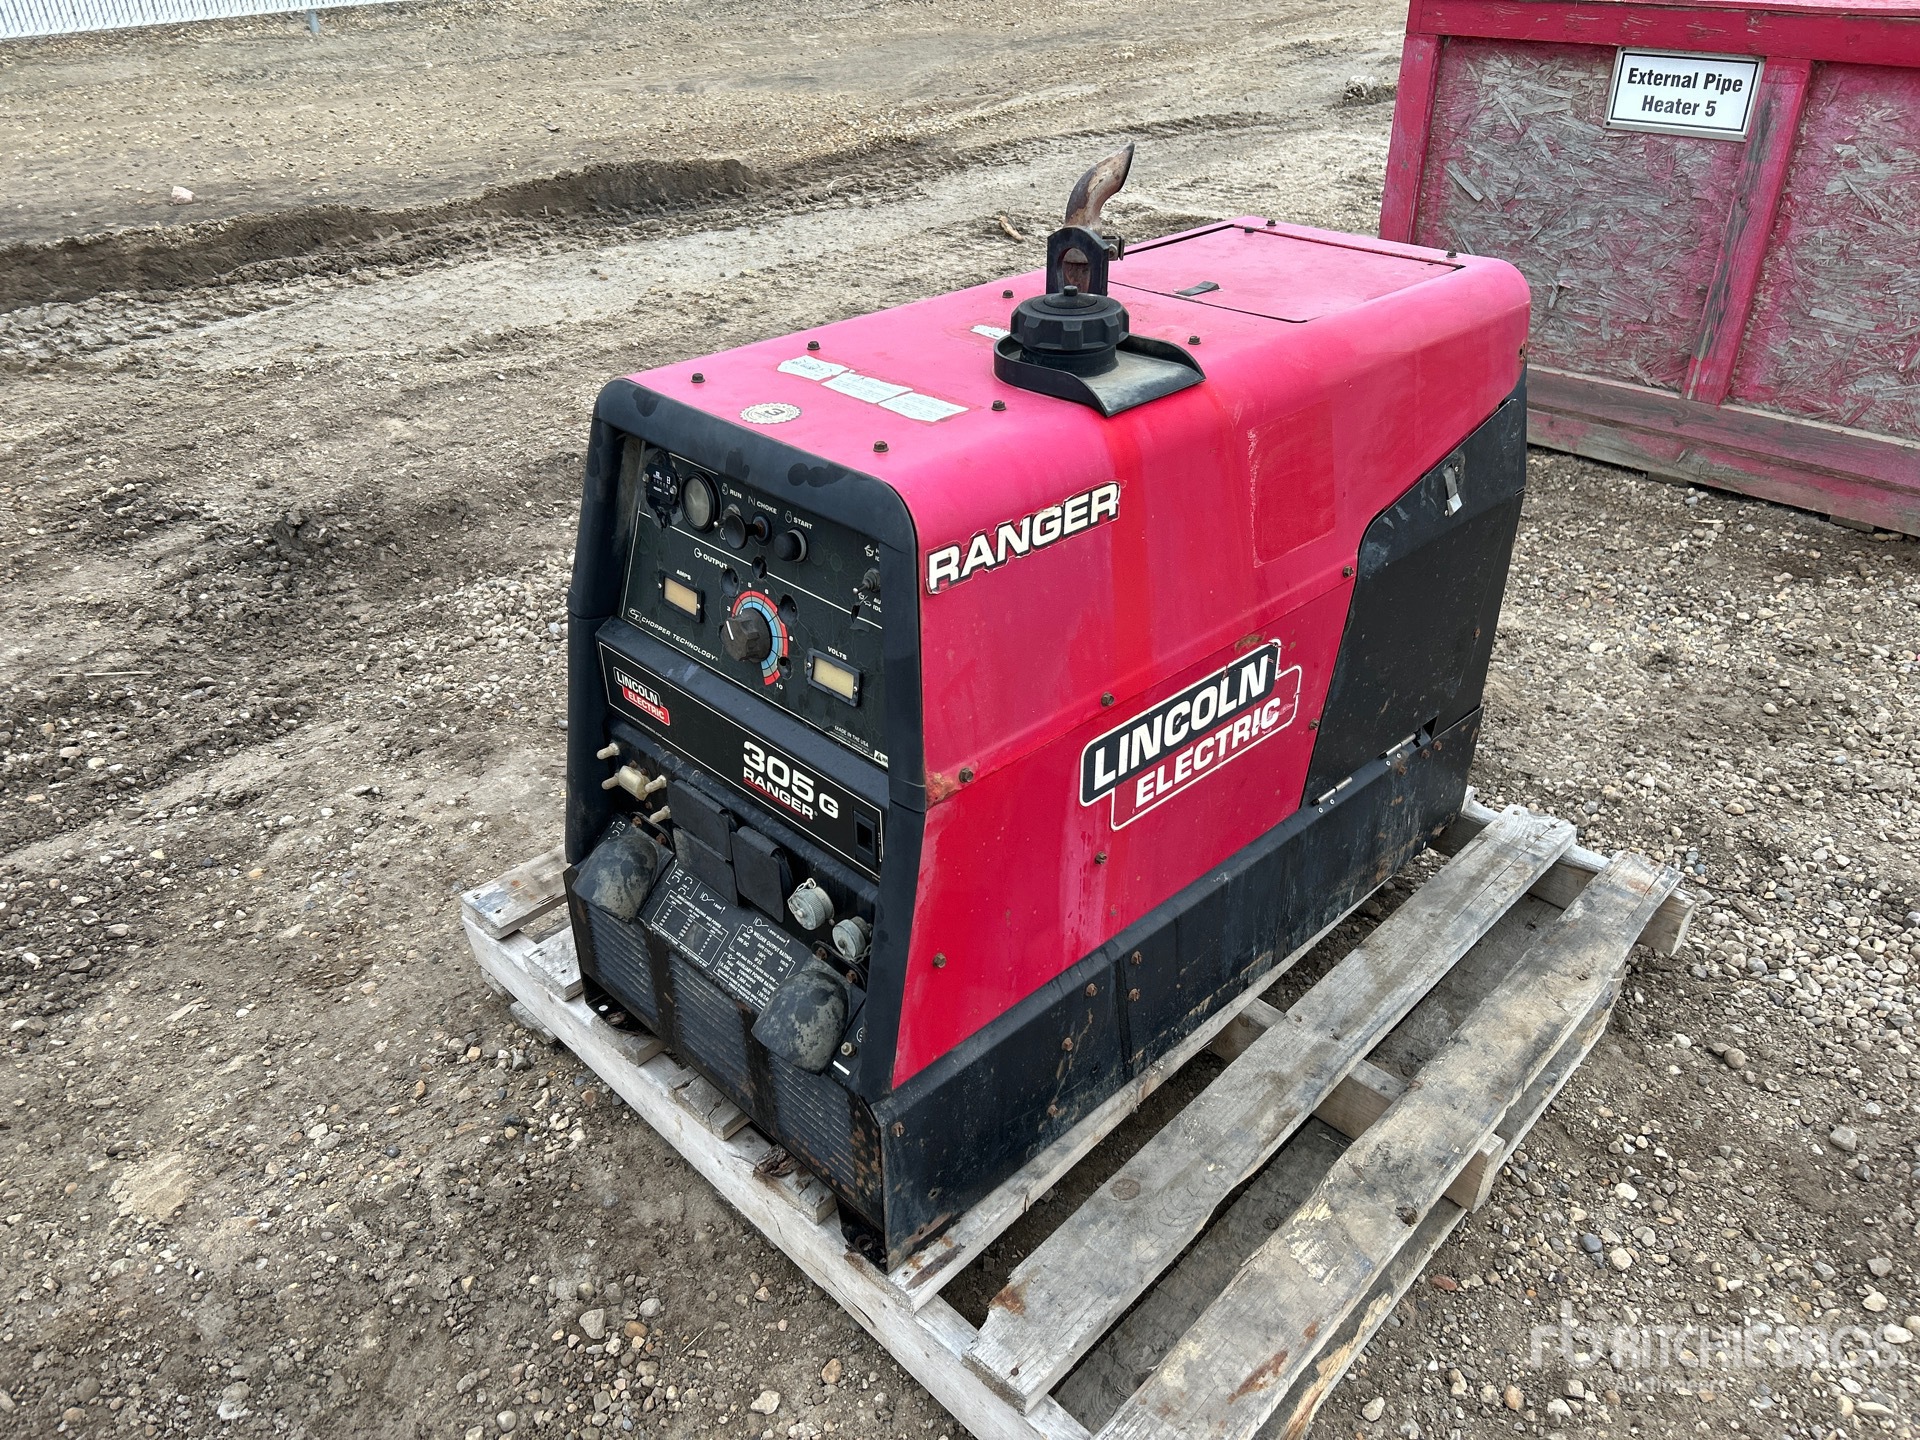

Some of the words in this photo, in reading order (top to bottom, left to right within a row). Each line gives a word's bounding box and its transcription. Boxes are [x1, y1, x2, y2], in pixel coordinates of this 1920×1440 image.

[1627, 67, 1699, 89] External
[1703, 73, 1743, 95] Pipe
[1641, 95, 1700, 116] Heater
[1705, 100, 1717, 117] 5
[730, 489, 742, 499] RUN
[756, 501, 778, 515] CHOKE
[793, 517, 813, 530] START
[929, 483, 1119, 590] RANGER
[703, 554, 728, 570] OUTPUT
[676, 569, 692, 581] AMPS
[641, 616, 672, 637] CHOPPER
[672, 633, 716, 660] TECHNOLOGY
[827, 646, 848, 661] VOLTS
[616, 670, 659, 706] LINCOLN
[776, 682, 784, 690] 10
[627, 690, 665, 720] ELECTRIC
[1094, 654, 1269, 791] LINCOLN
[1136, 697, 1281, 808] ELECTRIC
[743, 740, 815, 803] 305
[818, 792, 839, 819] G
[743, 766, 814, 821] RANGER
[765, 940, 780, 953] OUTPUT
[778, 949, 792, 962] RATING
[751, 971, 764, 983] POWER
